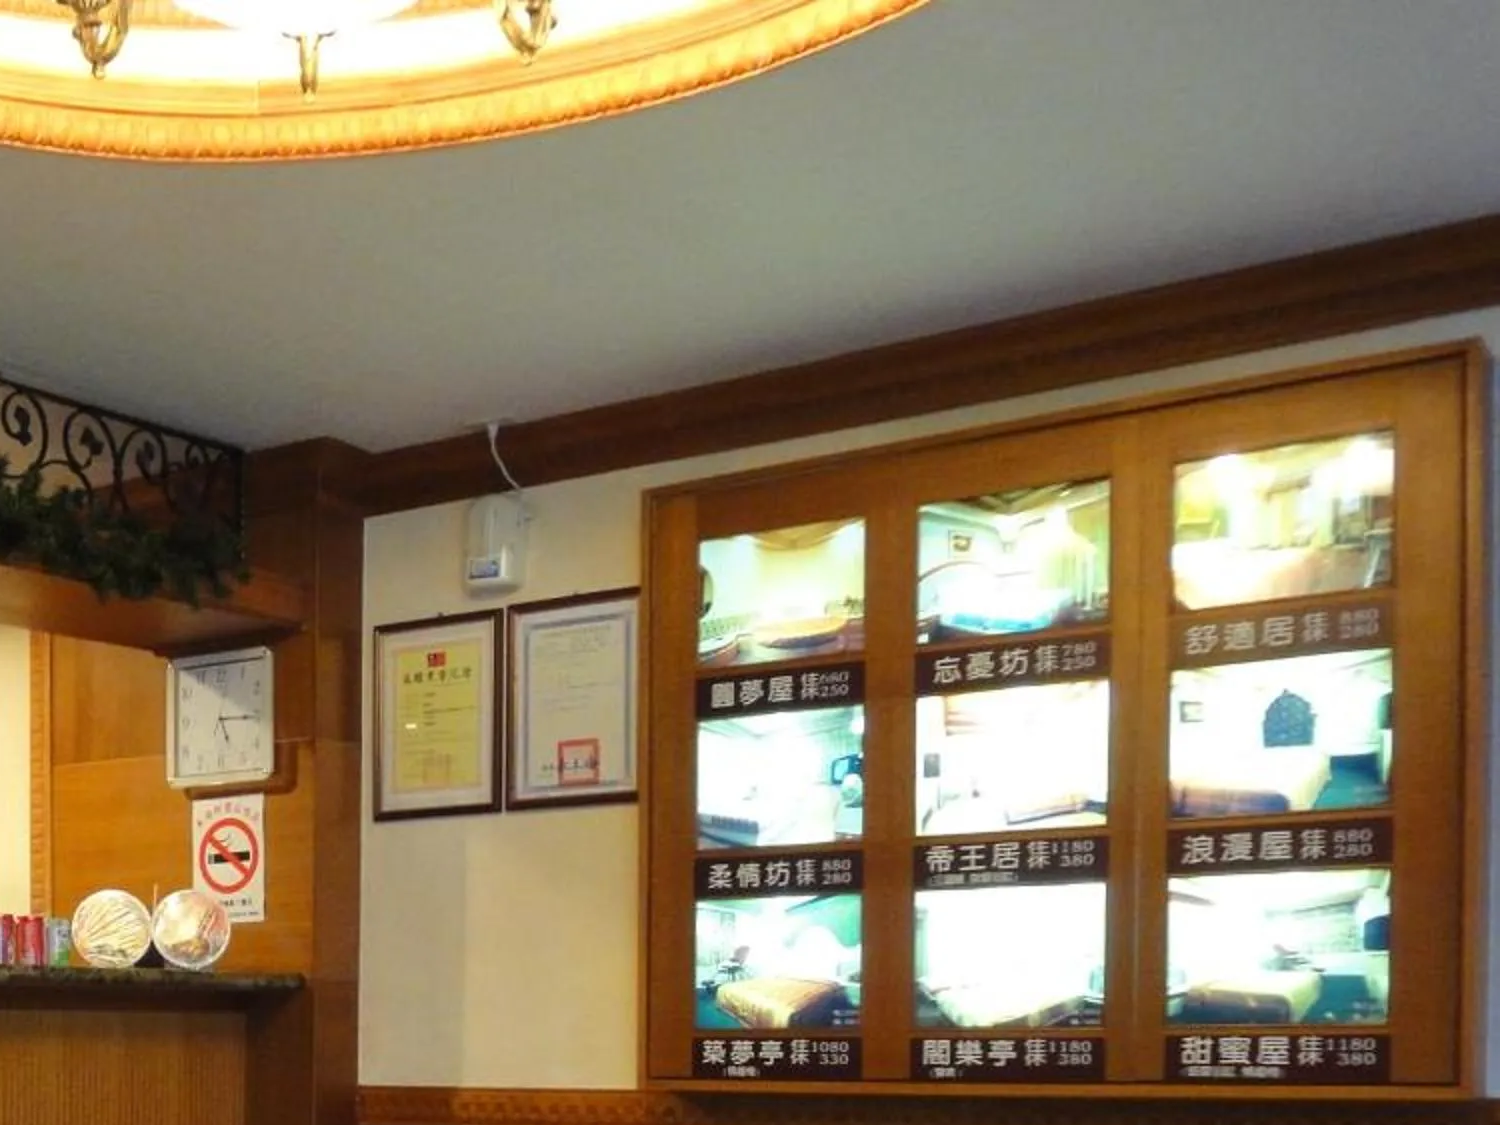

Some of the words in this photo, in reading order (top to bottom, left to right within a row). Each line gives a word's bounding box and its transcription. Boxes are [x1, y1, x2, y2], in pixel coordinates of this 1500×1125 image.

[933, 648, 1029, 684] 忘憂坊
[925, 841, 1021, 873] 帝王居
[1181, 829, 1294, 865] 浪漫屋
[708, 860, 791, 889] 柔情坊
[702, 1040, 784, 1066] 築夢亭
[1180, 1035, 1291, 1066] 甜蜜屋
